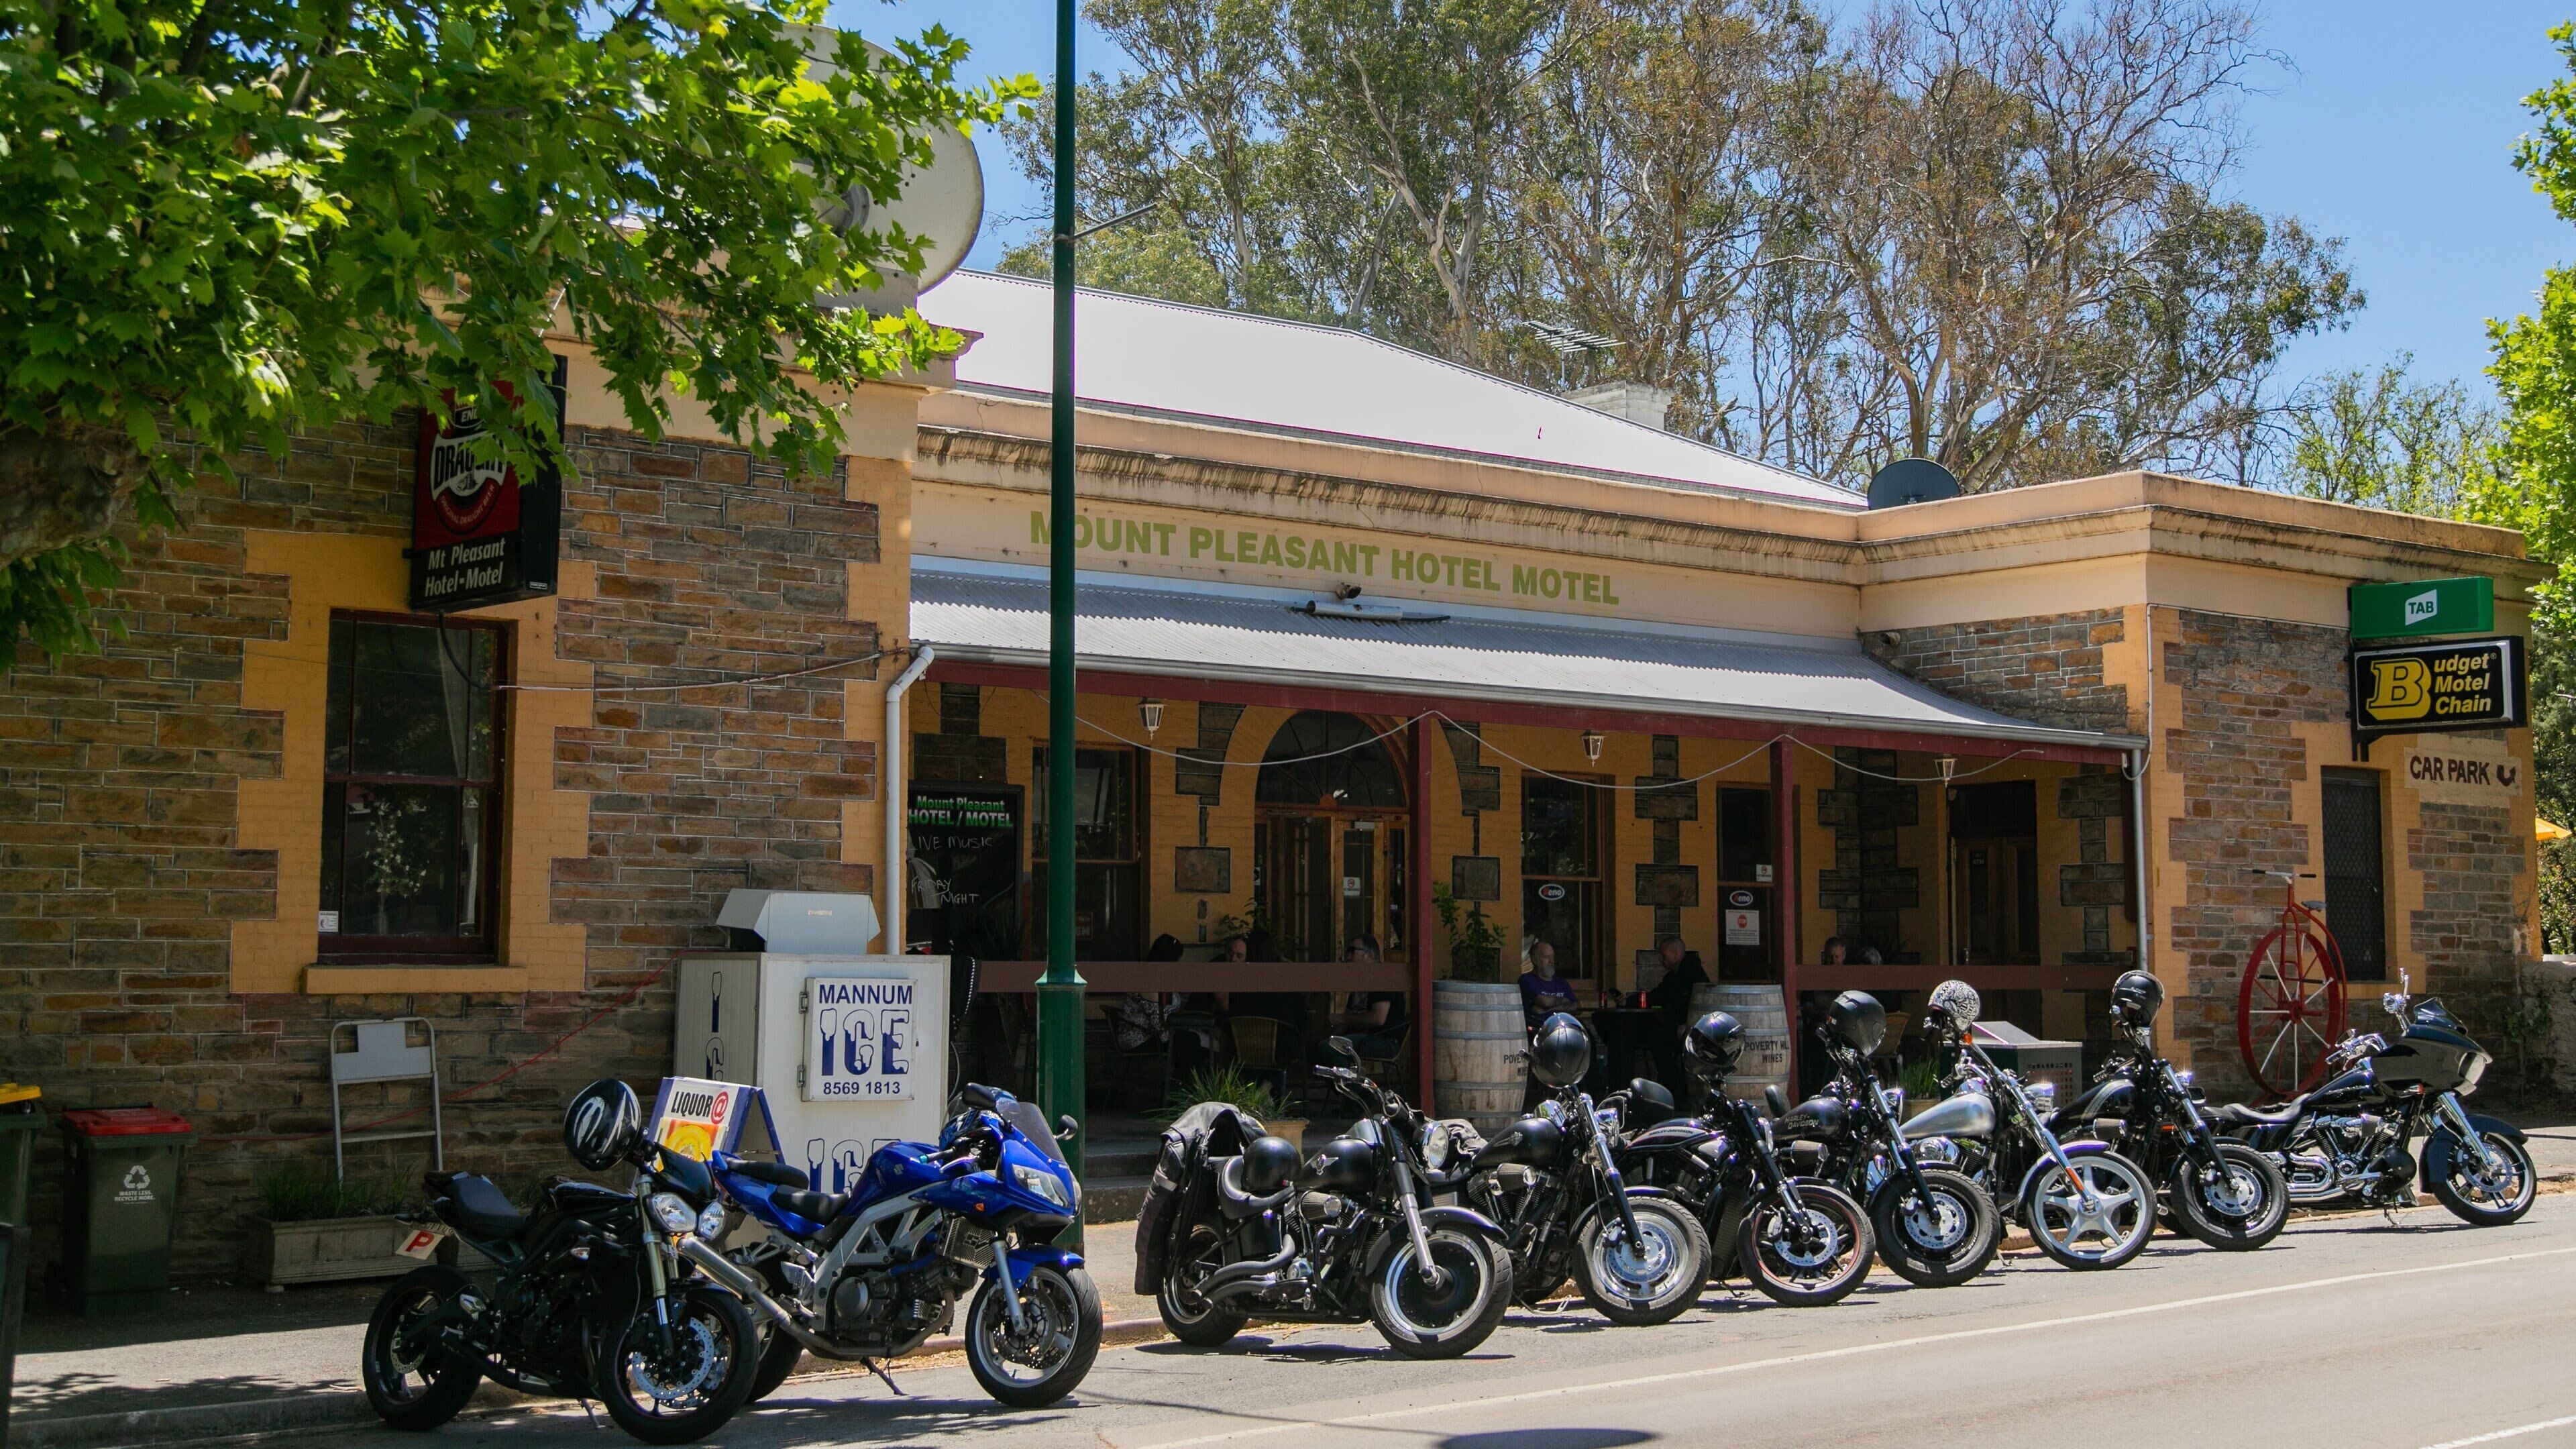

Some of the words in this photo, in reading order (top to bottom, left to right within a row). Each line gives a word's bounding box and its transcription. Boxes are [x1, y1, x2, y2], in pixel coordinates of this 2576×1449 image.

[434, 435, 502, 489] DRAU
[428, 550, 445, 570] Mt
[452, 538, 506, 564] Pleasant
[1030, 511, 1176, 556] MOUNT
[1189, 527, 1380, 576] PLEASANT
[1392, 549, 1501, 592] HOTEL
[1512, 564, 1619, 604] MOTEL
[425, 564, 503, 597] Hotel-Motel
[2408, 600, 2434, 615] TAB
[2434, 674, 2490, 693] Motel
[2435, 695, 2491, 714] Chain
[2410, 755, 2444, 781] CAR
[2448, 759, 2490, 786] PARK
[917, 796, 954, 809] Mount
[957, 797, 1005, 811] Pleasant
[908, 809, 954, 825] HOTEL
[957, 812, 962, 826] /
[966, 812, 1013, 827] MOTEL
[949, 836, 993, 849] MUSIC
[941, 891, 980, 905] NIGHT
[818, 984, 912, 1004] MANNUM
[819, 1008, 910, 1076] ICE
[1744, 1040, 1778, 1051] POVERTY
[1762, 1054, 1782, 1063] WINES
[823, 1081, 860, 1095] 8569
[865, 1081, 900, 1095] 1813
[1788, 1119, 1819, 1130] DAVIDSON
[807, 1138, 901, 1193] IC
[405, 1231, 435, 1252] P
